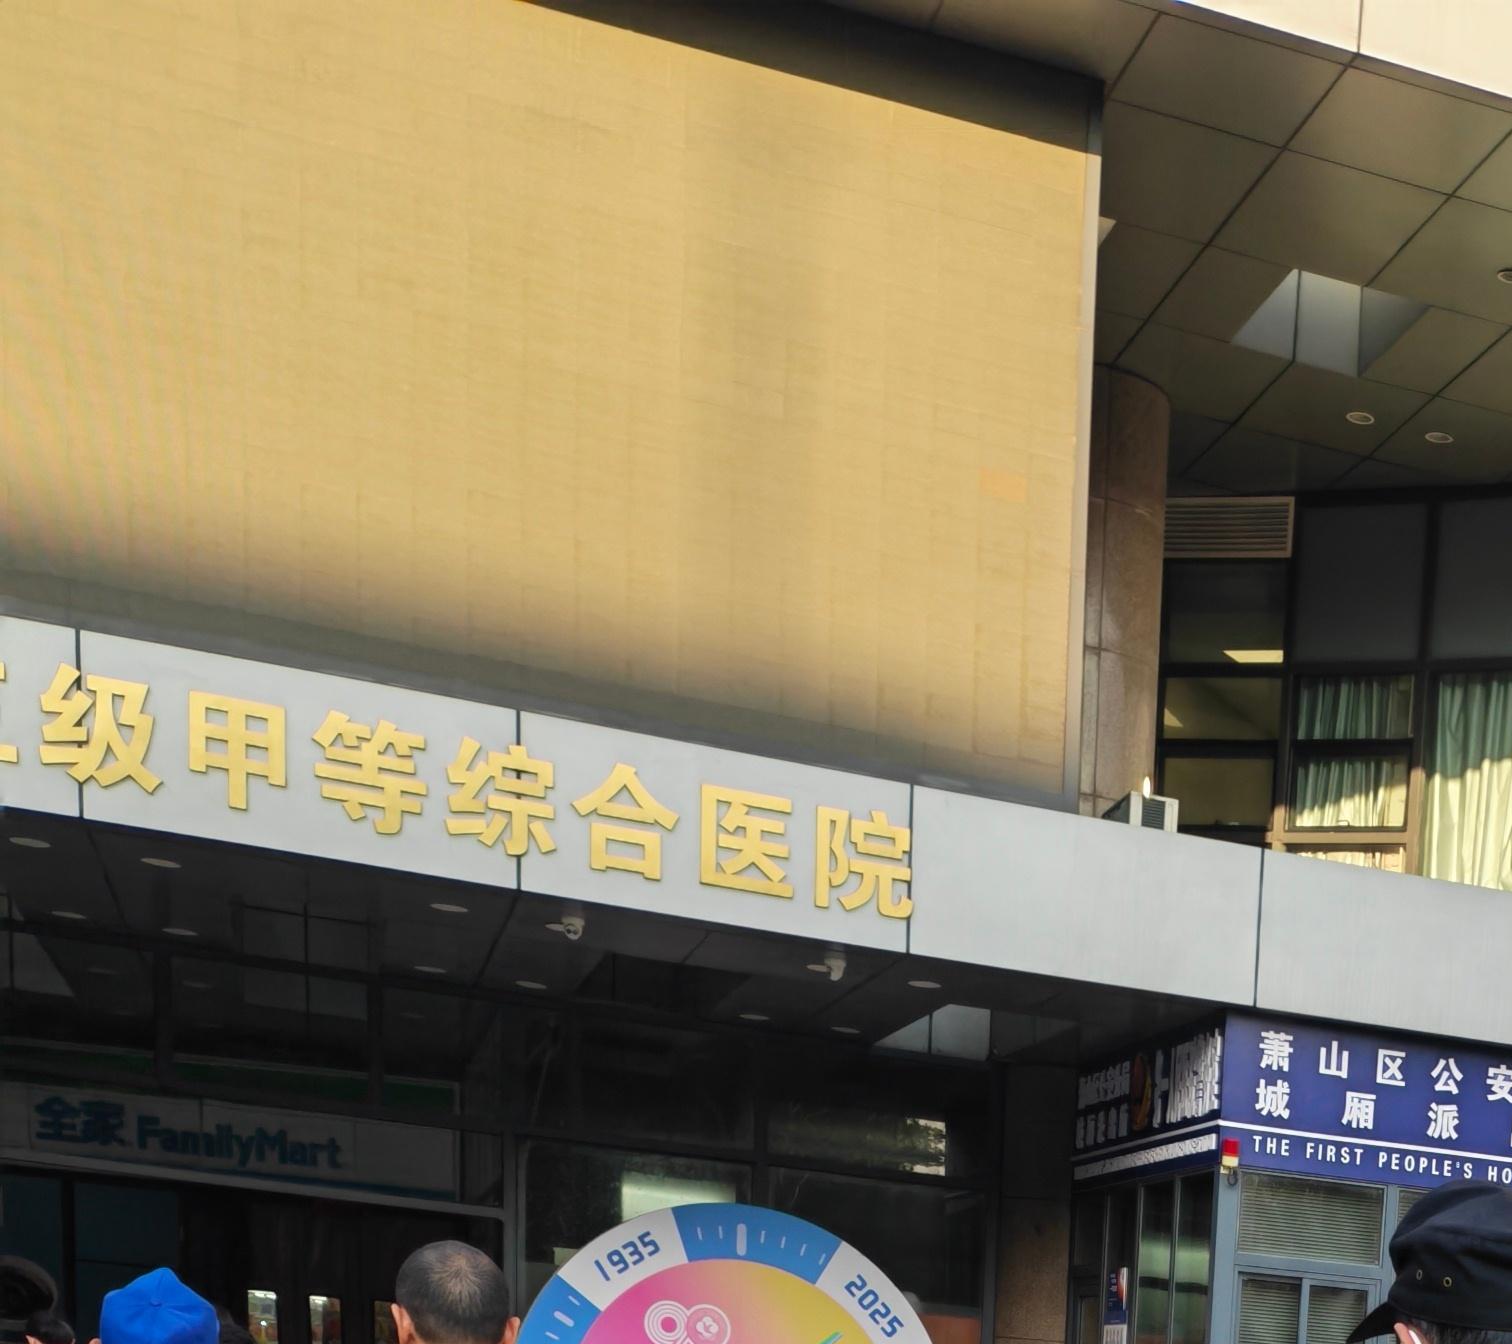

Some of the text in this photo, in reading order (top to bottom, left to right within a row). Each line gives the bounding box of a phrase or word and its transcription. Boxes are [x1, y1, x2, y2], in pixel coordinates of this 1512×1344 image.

[0, 662, 914, 918] 级甲等综合医院
[34, 1096, 341, 1168] 全家 FamilyMart
[1252, 1135, 1291, 1157] THE
[1305, 1142, 1364, 1166] FIRST
[1378, 1151, 1474, 1179] PEOPLE'S
[594, 1230, 661, 1282] 1935
[843, 1273, 905, 1339] 2025
